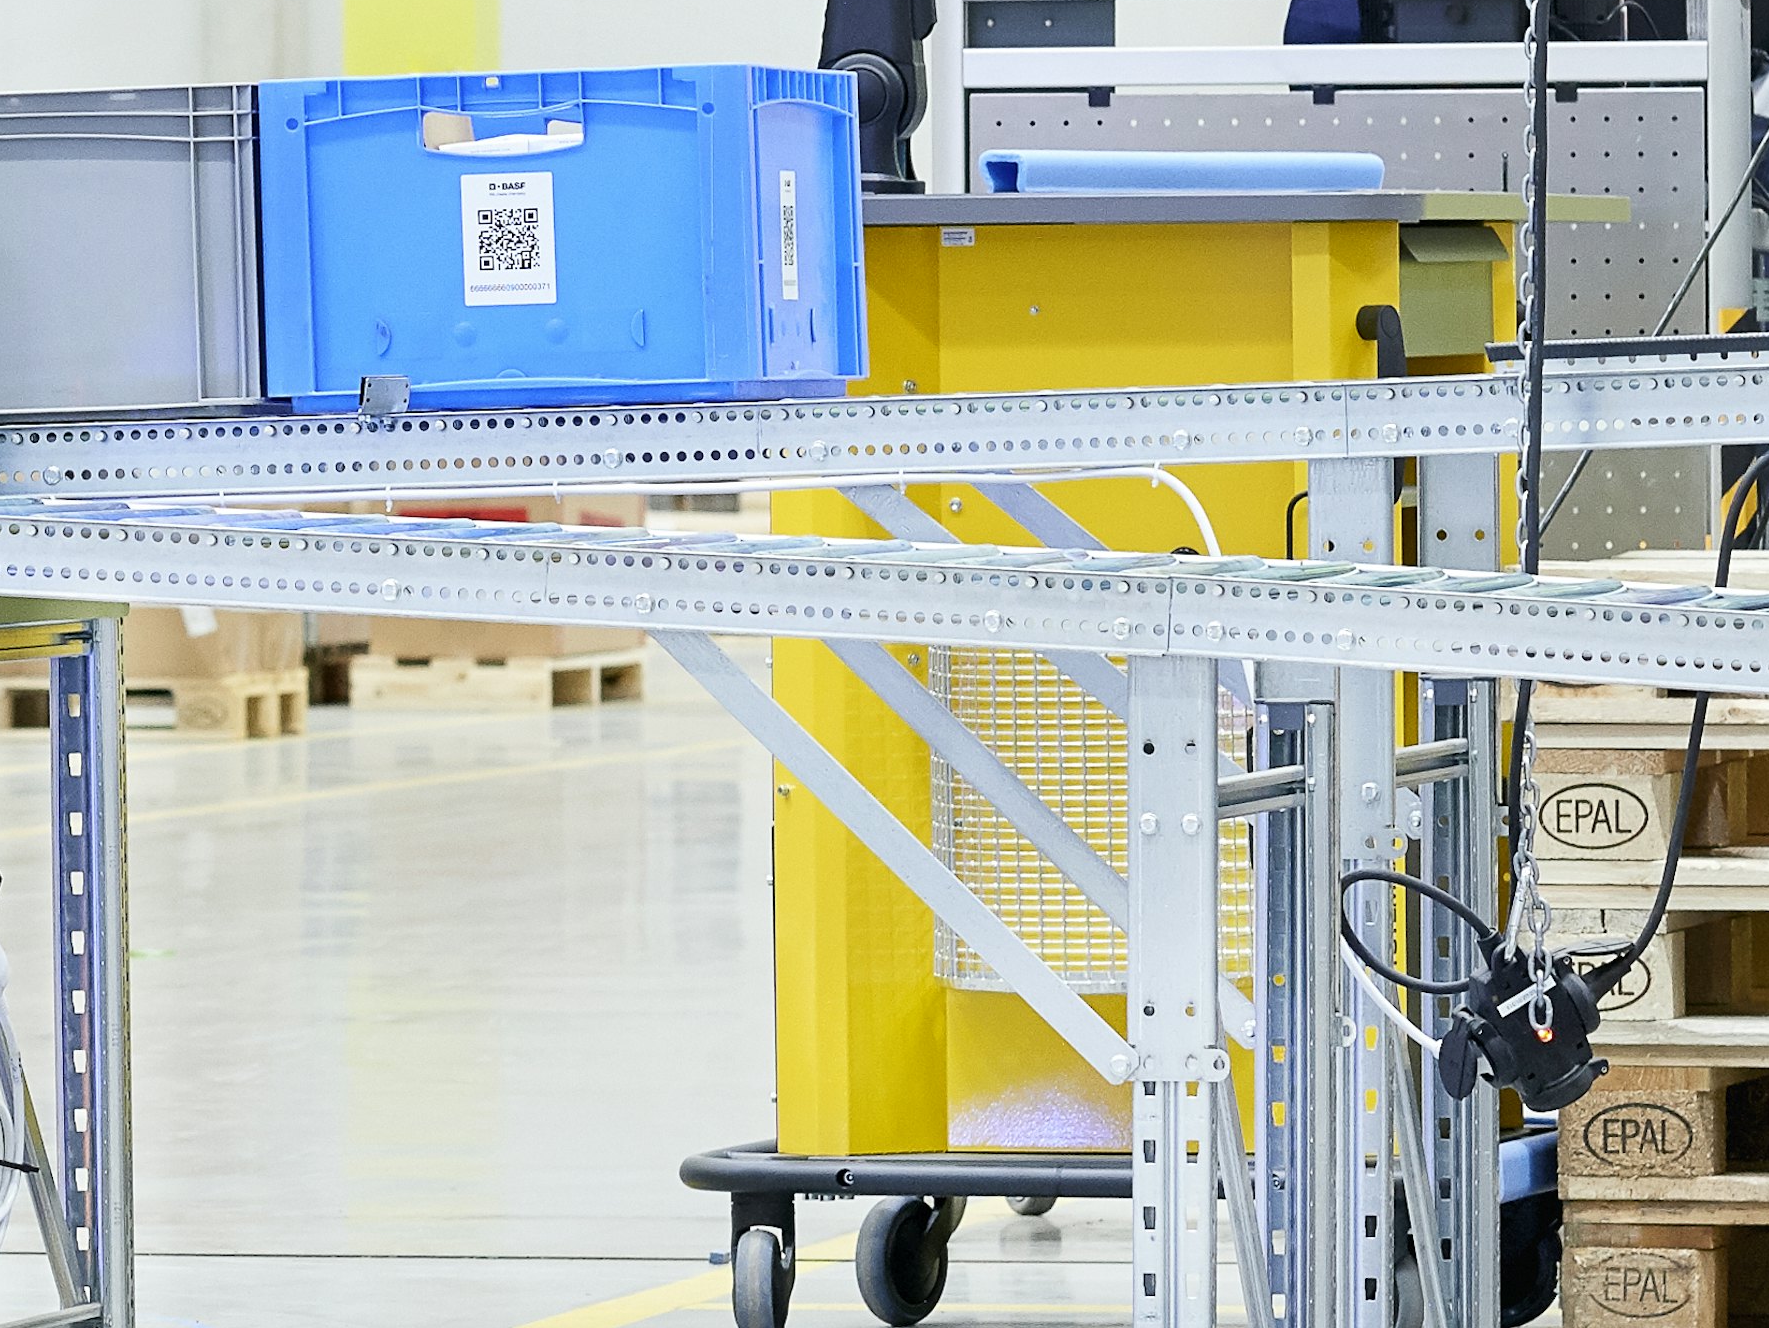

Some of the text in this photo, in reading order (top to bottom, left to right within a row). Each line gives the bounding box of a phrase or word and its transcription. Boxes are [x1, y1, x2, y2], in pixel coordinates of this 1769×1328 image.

[502, 182, 526, 190] BASF
[1556, 799, 1632, 834] EPAL
[1603, 1118, 1677, 1155] EPAL
[1604, 1267, 1678, 1304] EPAL
